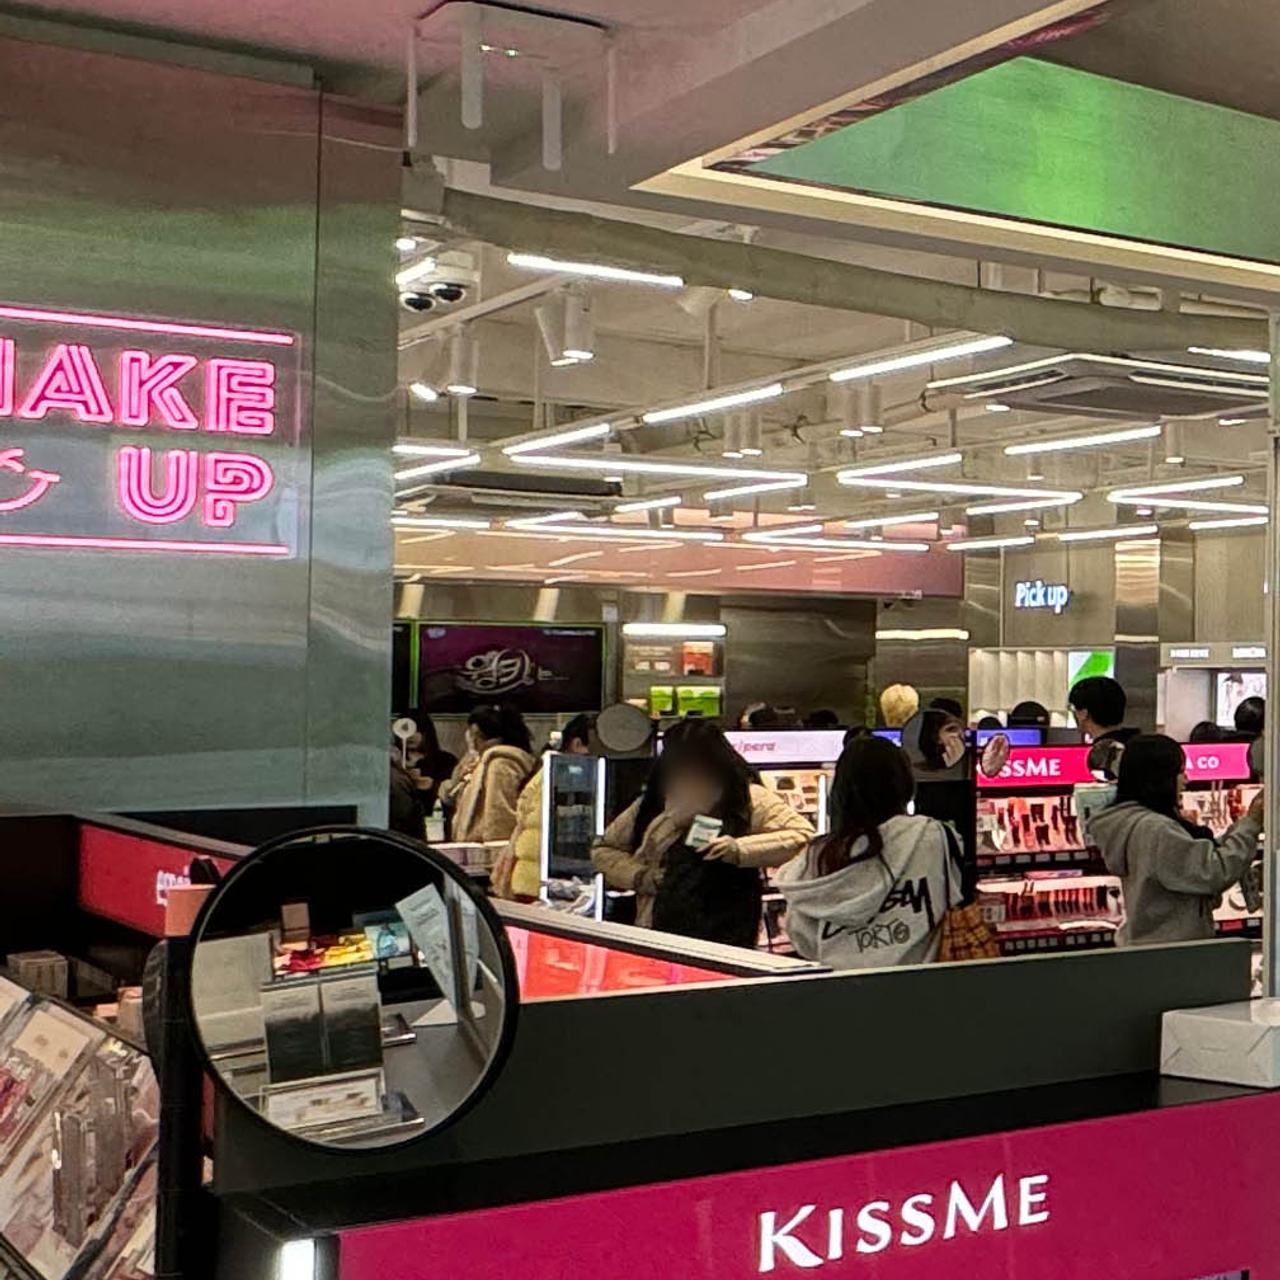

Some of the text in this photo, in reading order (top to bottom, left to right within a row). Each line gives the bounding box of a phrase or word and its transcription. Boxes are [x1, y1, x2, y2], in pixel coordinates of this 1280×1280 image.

[118, 447, 275, 528] UP
[1015, 581, 1069, 614] Pick up
[978, 758, 1061, 778] SSME
